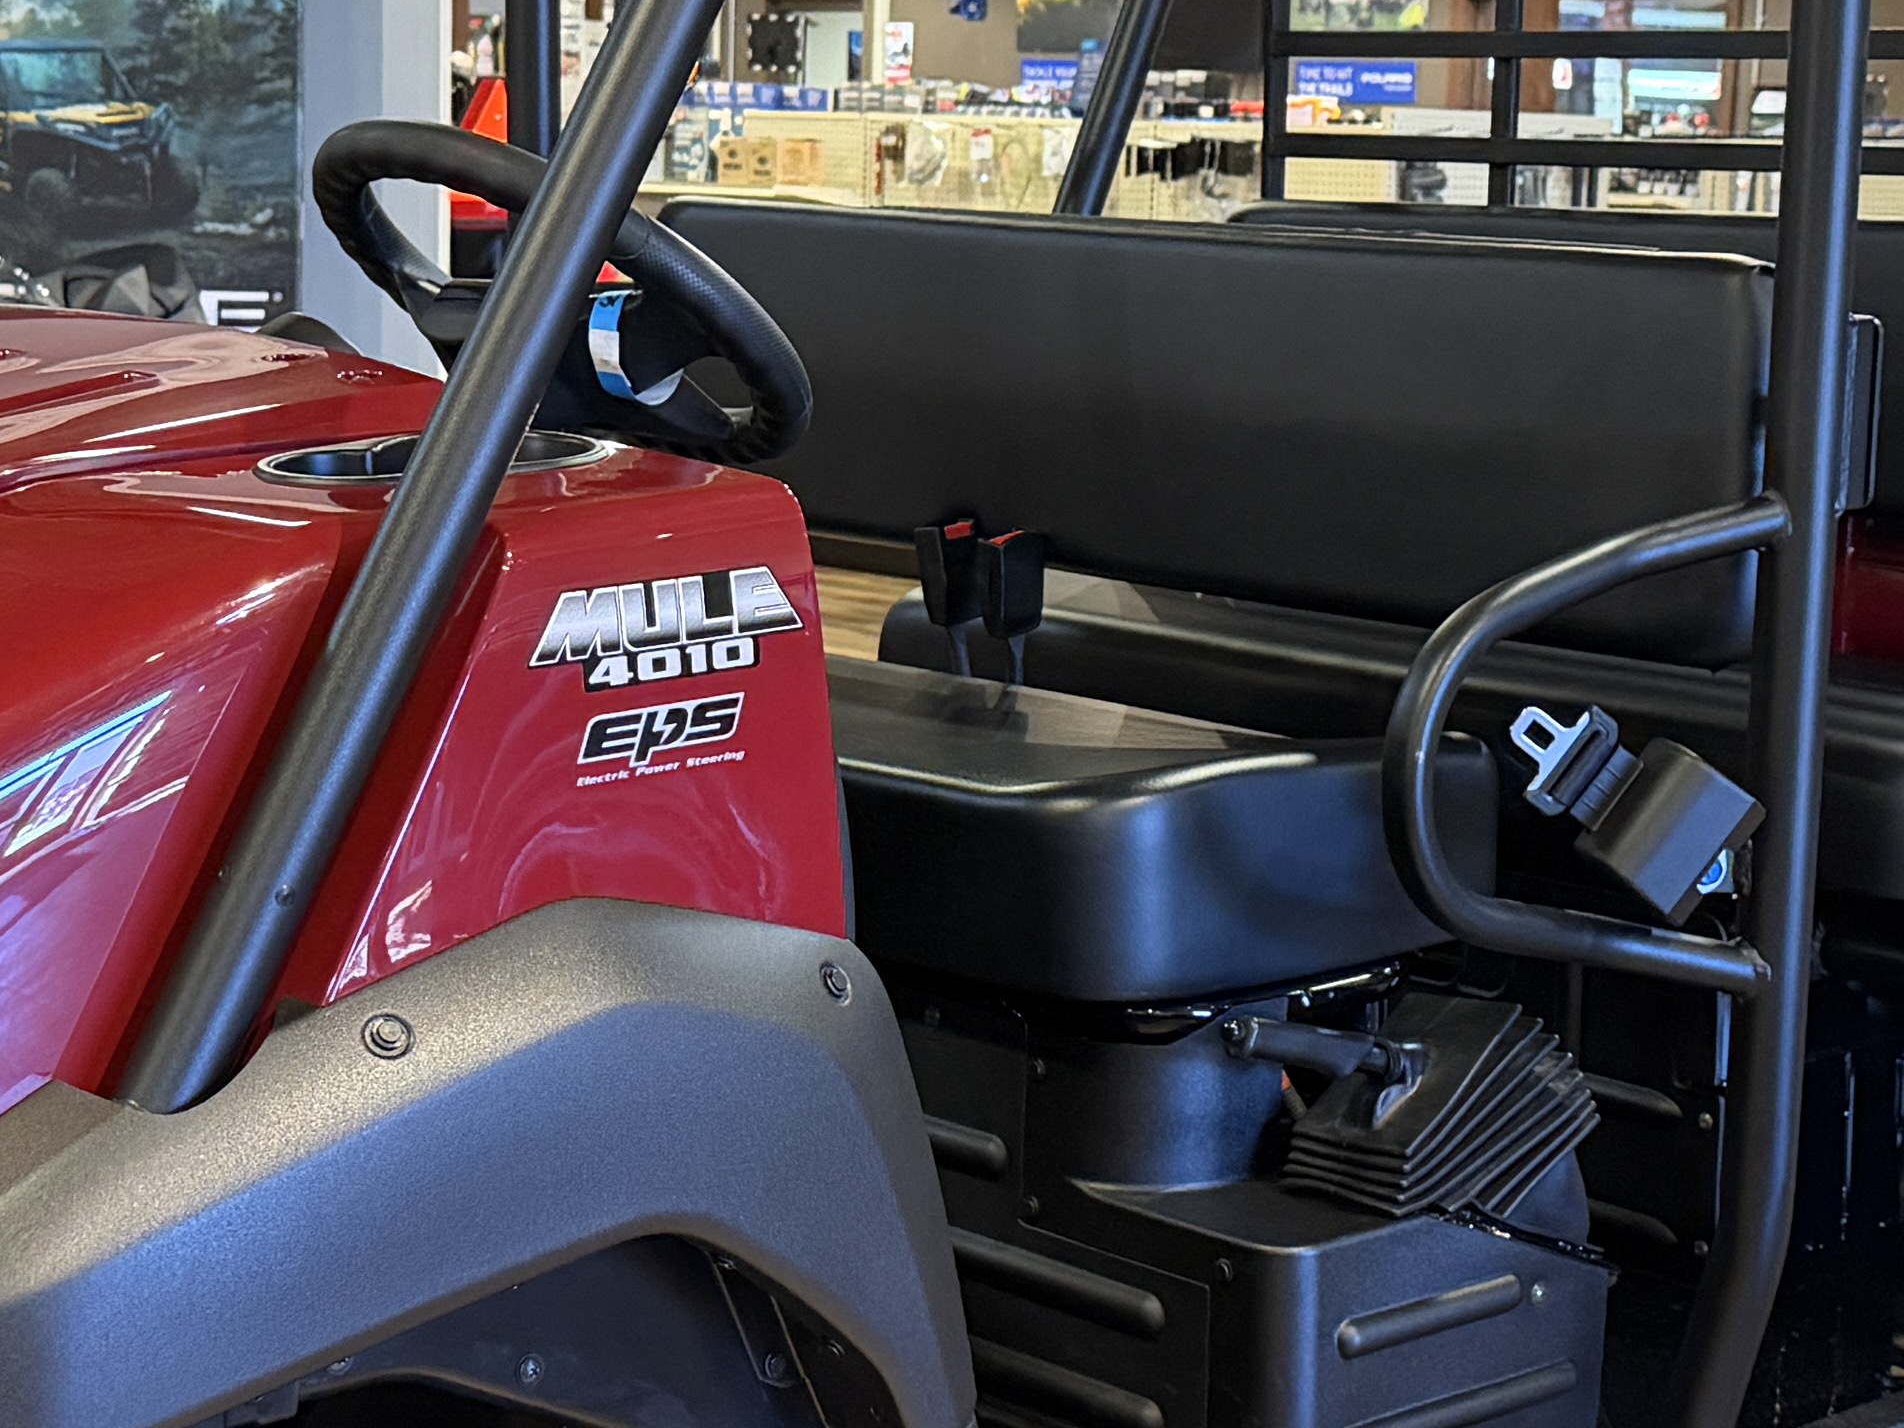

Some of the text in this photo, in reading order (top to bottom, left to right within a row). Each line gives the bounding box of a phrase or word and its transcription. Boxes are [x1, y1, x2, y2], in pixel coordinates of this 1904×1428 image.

[527, 565, 804, 668] MULE
[588, 638, 755, 687] 4010
[577, 691, 745, 767] EPS
[576, 750, 745, 786] Electric Power Steering
